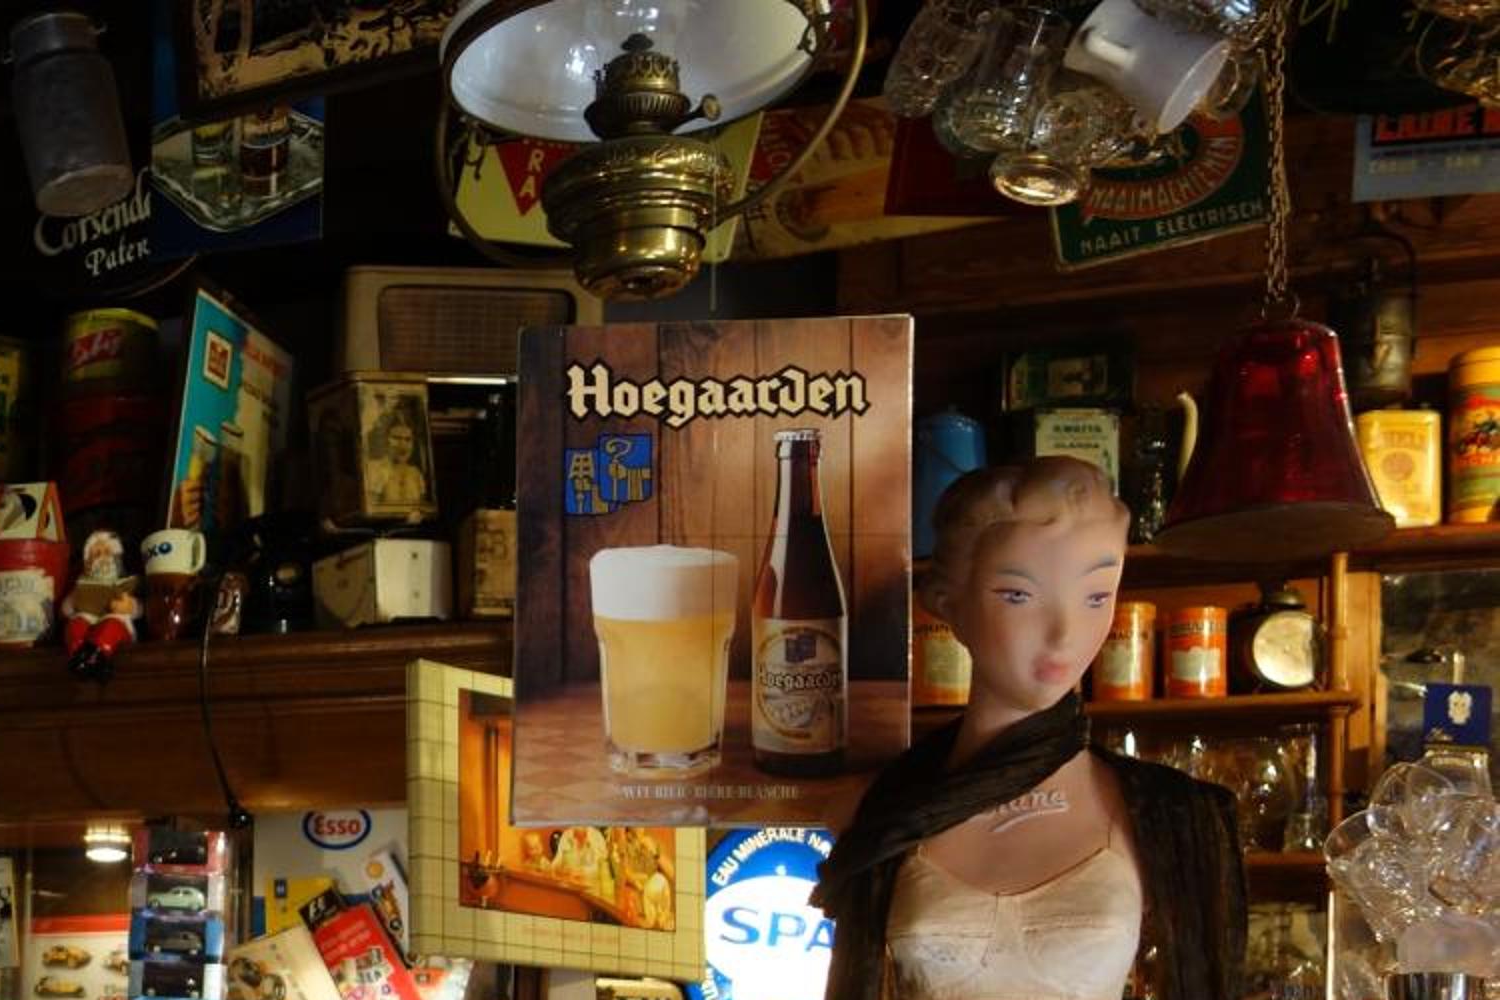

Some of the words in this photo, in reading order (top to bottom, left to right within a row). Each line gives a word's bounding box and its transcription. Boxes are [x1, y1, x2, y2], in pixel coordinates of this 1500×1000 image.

[566, 364, 869, 430] Hoegaarden
[314, 816, 360, 836] Esso
[711, 854, 742, 886] EAU
[732, 827, 806, 866] MINERALE
[720, 906, 836, 952] SPA
